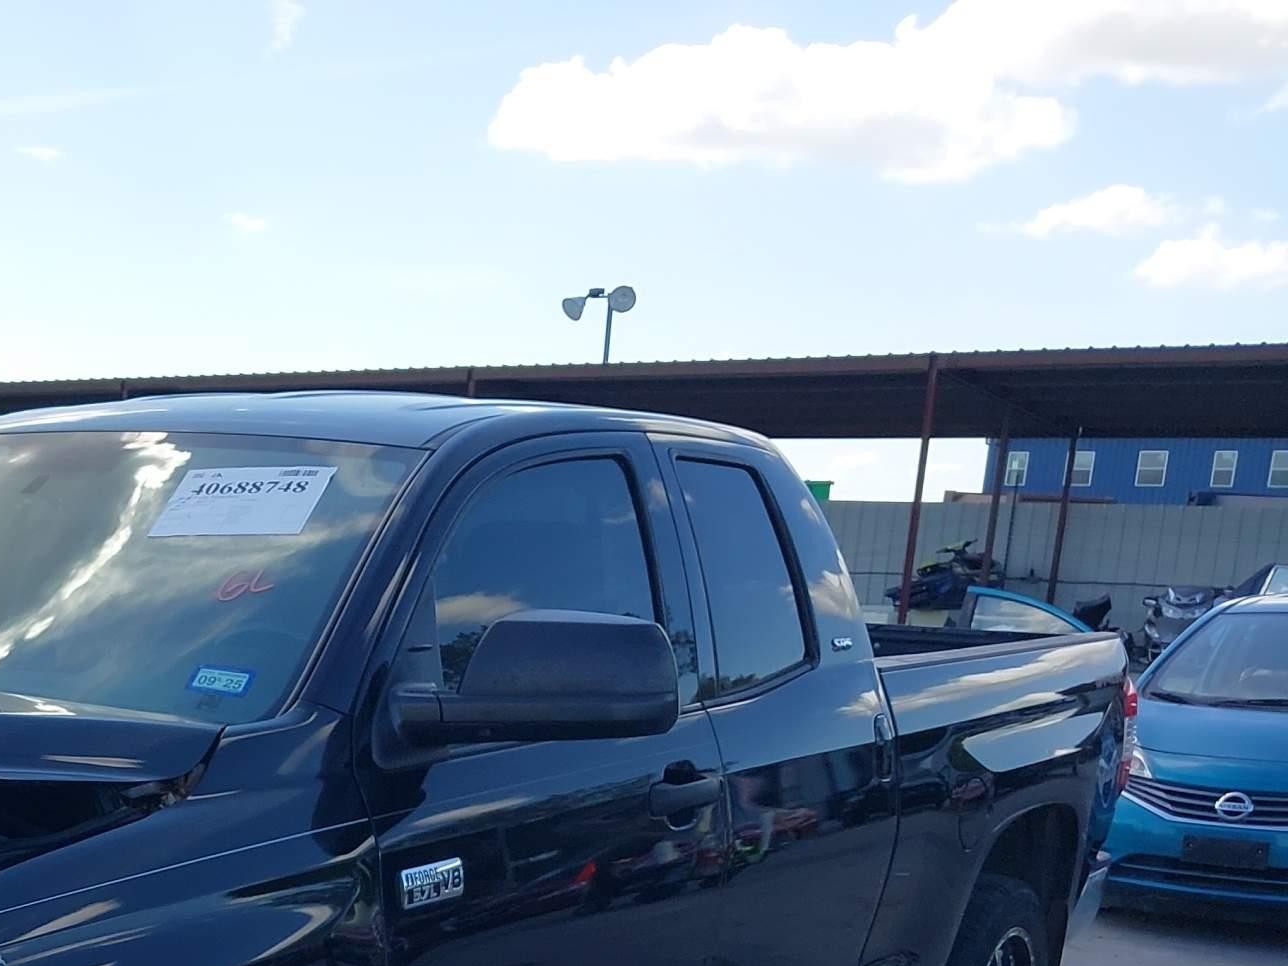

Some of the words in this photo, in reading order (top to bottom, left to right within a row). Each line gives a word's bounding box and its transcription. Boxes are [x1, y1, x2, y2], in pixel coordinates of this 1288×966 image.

[191, 480, 309, 496] 40688748
[198, 674, 217, 686] 09
[223, 678, 244, 690] 25
